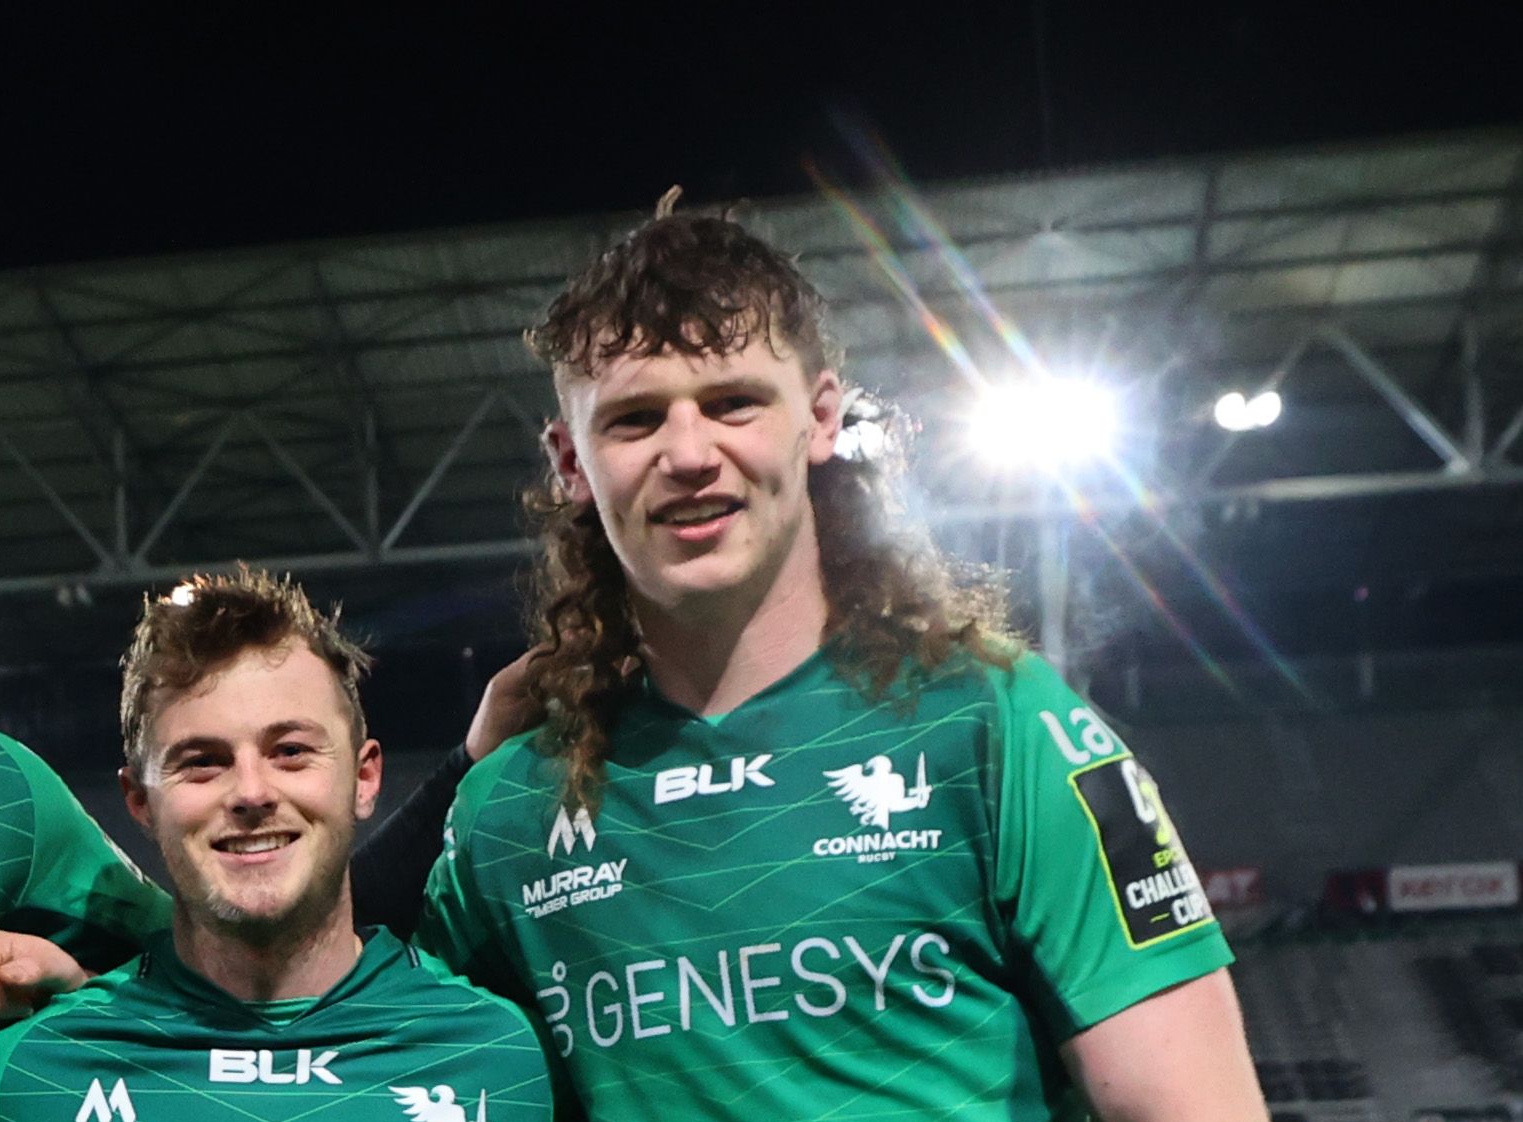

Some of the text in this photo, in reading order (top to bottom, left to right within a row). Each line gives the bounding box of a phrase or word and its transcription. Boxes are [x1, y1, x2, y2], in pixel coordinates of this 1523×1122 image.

[654, 753, 776, 805] BLK
[812, 829, 943, 857] CONNACHT
[857, 851, 897, 864] RUGBY
[522, 858, 628, 906] MURRAY
[525, 883, 624, 919] TIMBER GROUP
[585, 932, 957, 1048] GENESYS
[209, 1048, 344, 1085] BLK
